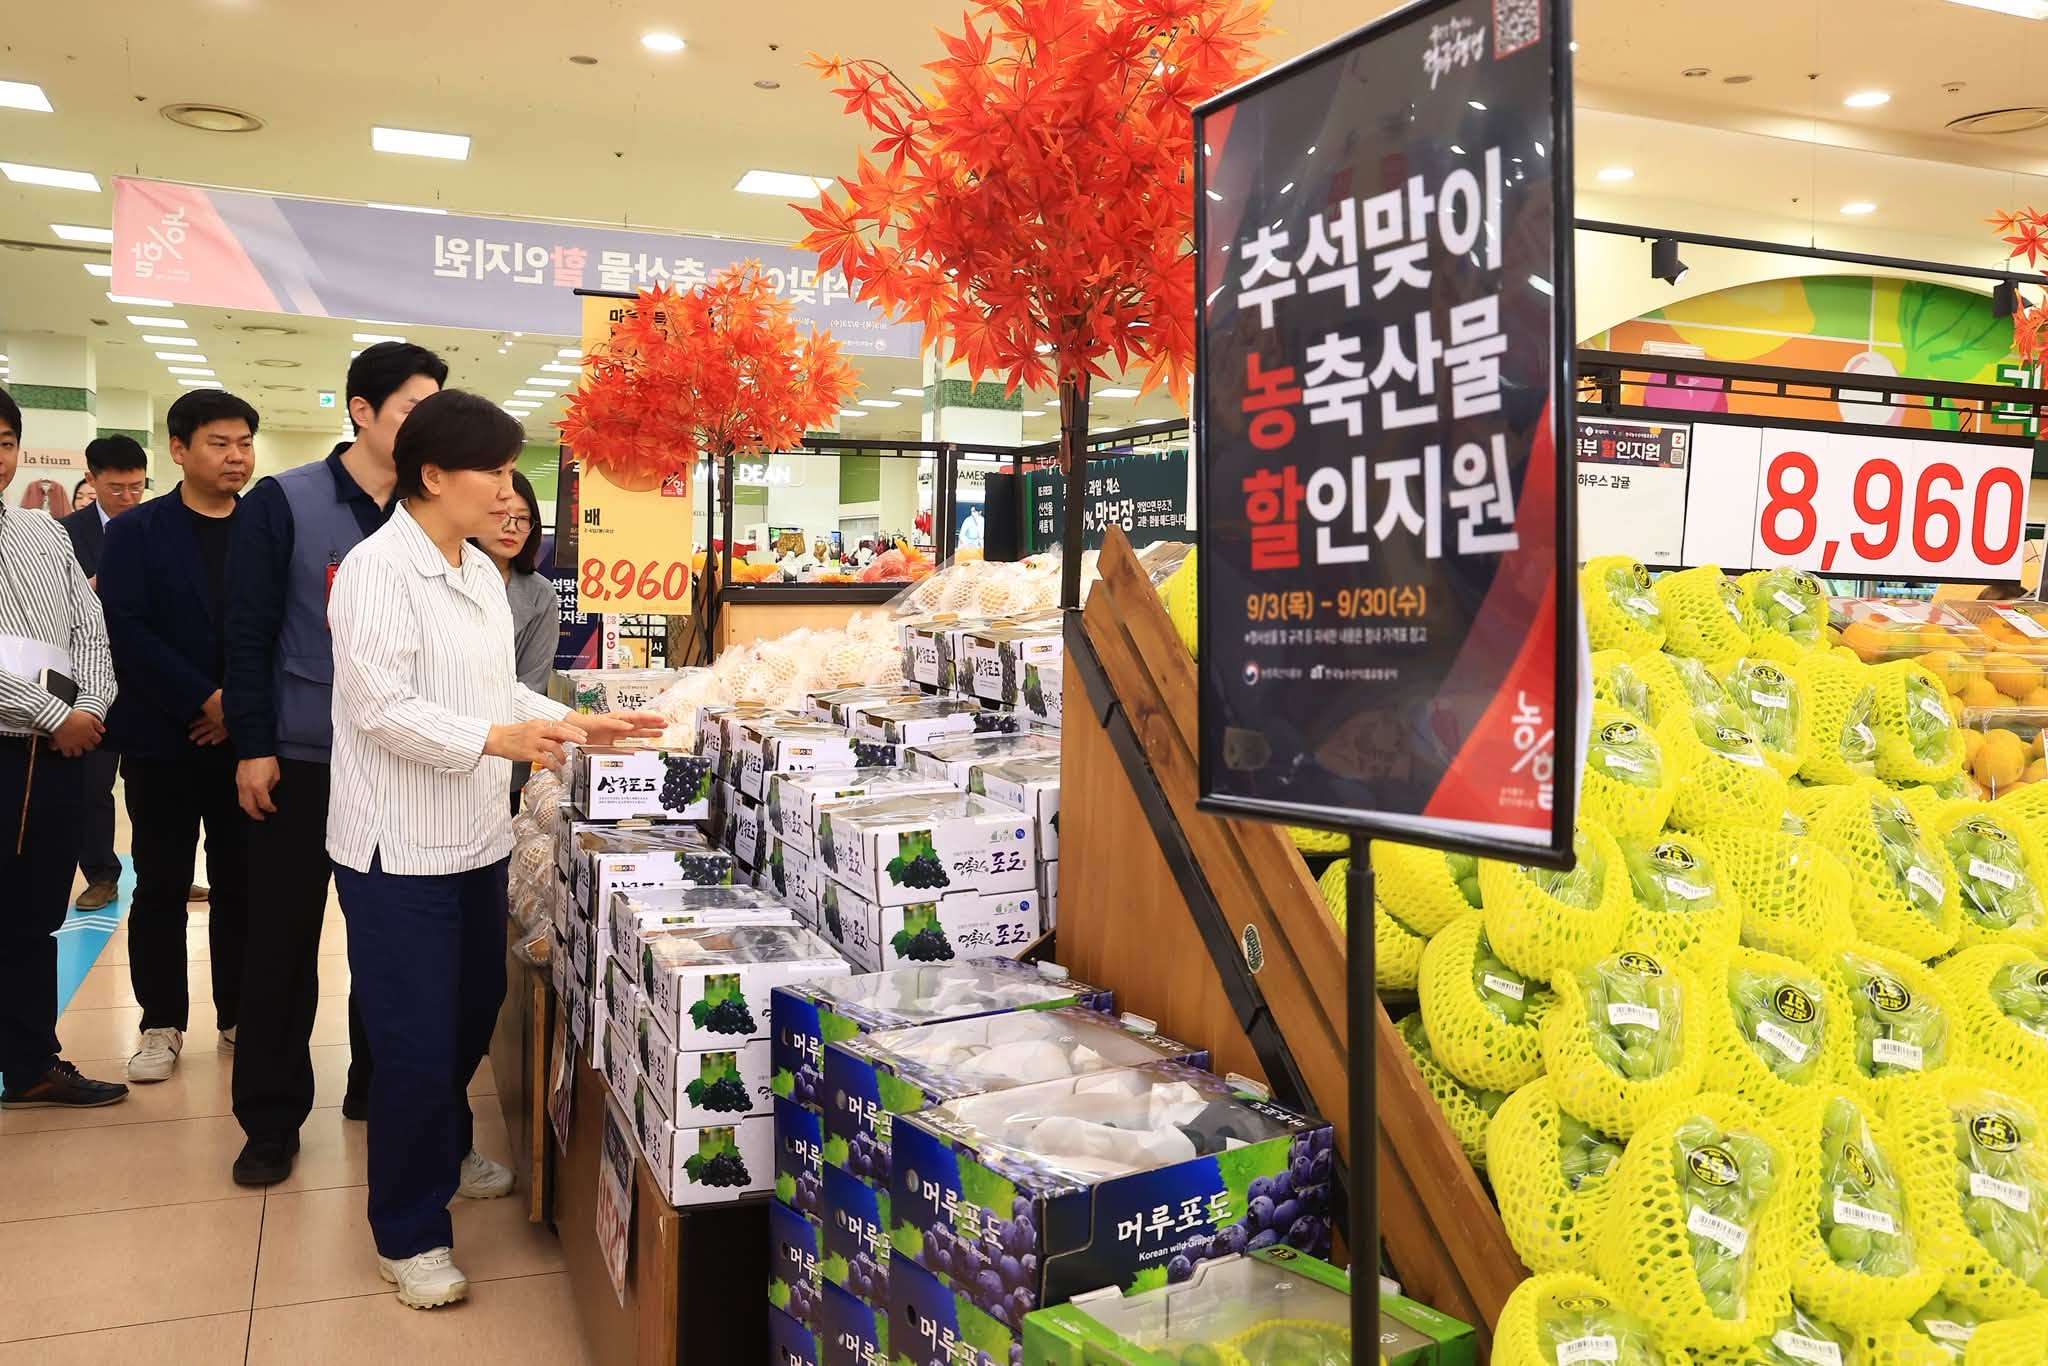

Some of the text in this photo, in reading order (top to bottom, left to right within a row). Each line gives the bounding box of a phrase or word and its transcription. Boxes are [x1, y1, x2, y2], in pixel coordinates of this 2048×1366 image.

[1237, 146, 1504, 329] 추석맞이
[1241, 295, 1508, 449] 농축산물
[23, 451, 71, 465] la tium
[1602, 438, 1661, 461] 할인지원
[739, 463, 792, 483] DEAN
[1577, 473, 1631, 489] 하우스 감귤
[584, 508, 600, 526] 배
[1096, 498, 1135, 533] 맛보장
[1242, 433, 1519, 570] 할인지원
[1761, 450, 2025, 571] 8,960
[580, 557, 690, 602] 8,960
[1247, 591, 1313, 621] 9/3(목)
[1337, 585, 1427, 618] 9/30(수)
[597, 775, 657, 794] 상주포도
[990, 851, 1024, 875] 포도
[995, 923, 1029, 947] 포도
[848, 1096, 893, 1137] 머루포
[922, 1180, 1004, 1250] 머루포도
[1117, 1190, 1233, 1247] 머루포도
[848, 1216, 891, 1260] 머루포
[1139, 1234, 1217, 1262] Korean wild Grapes
